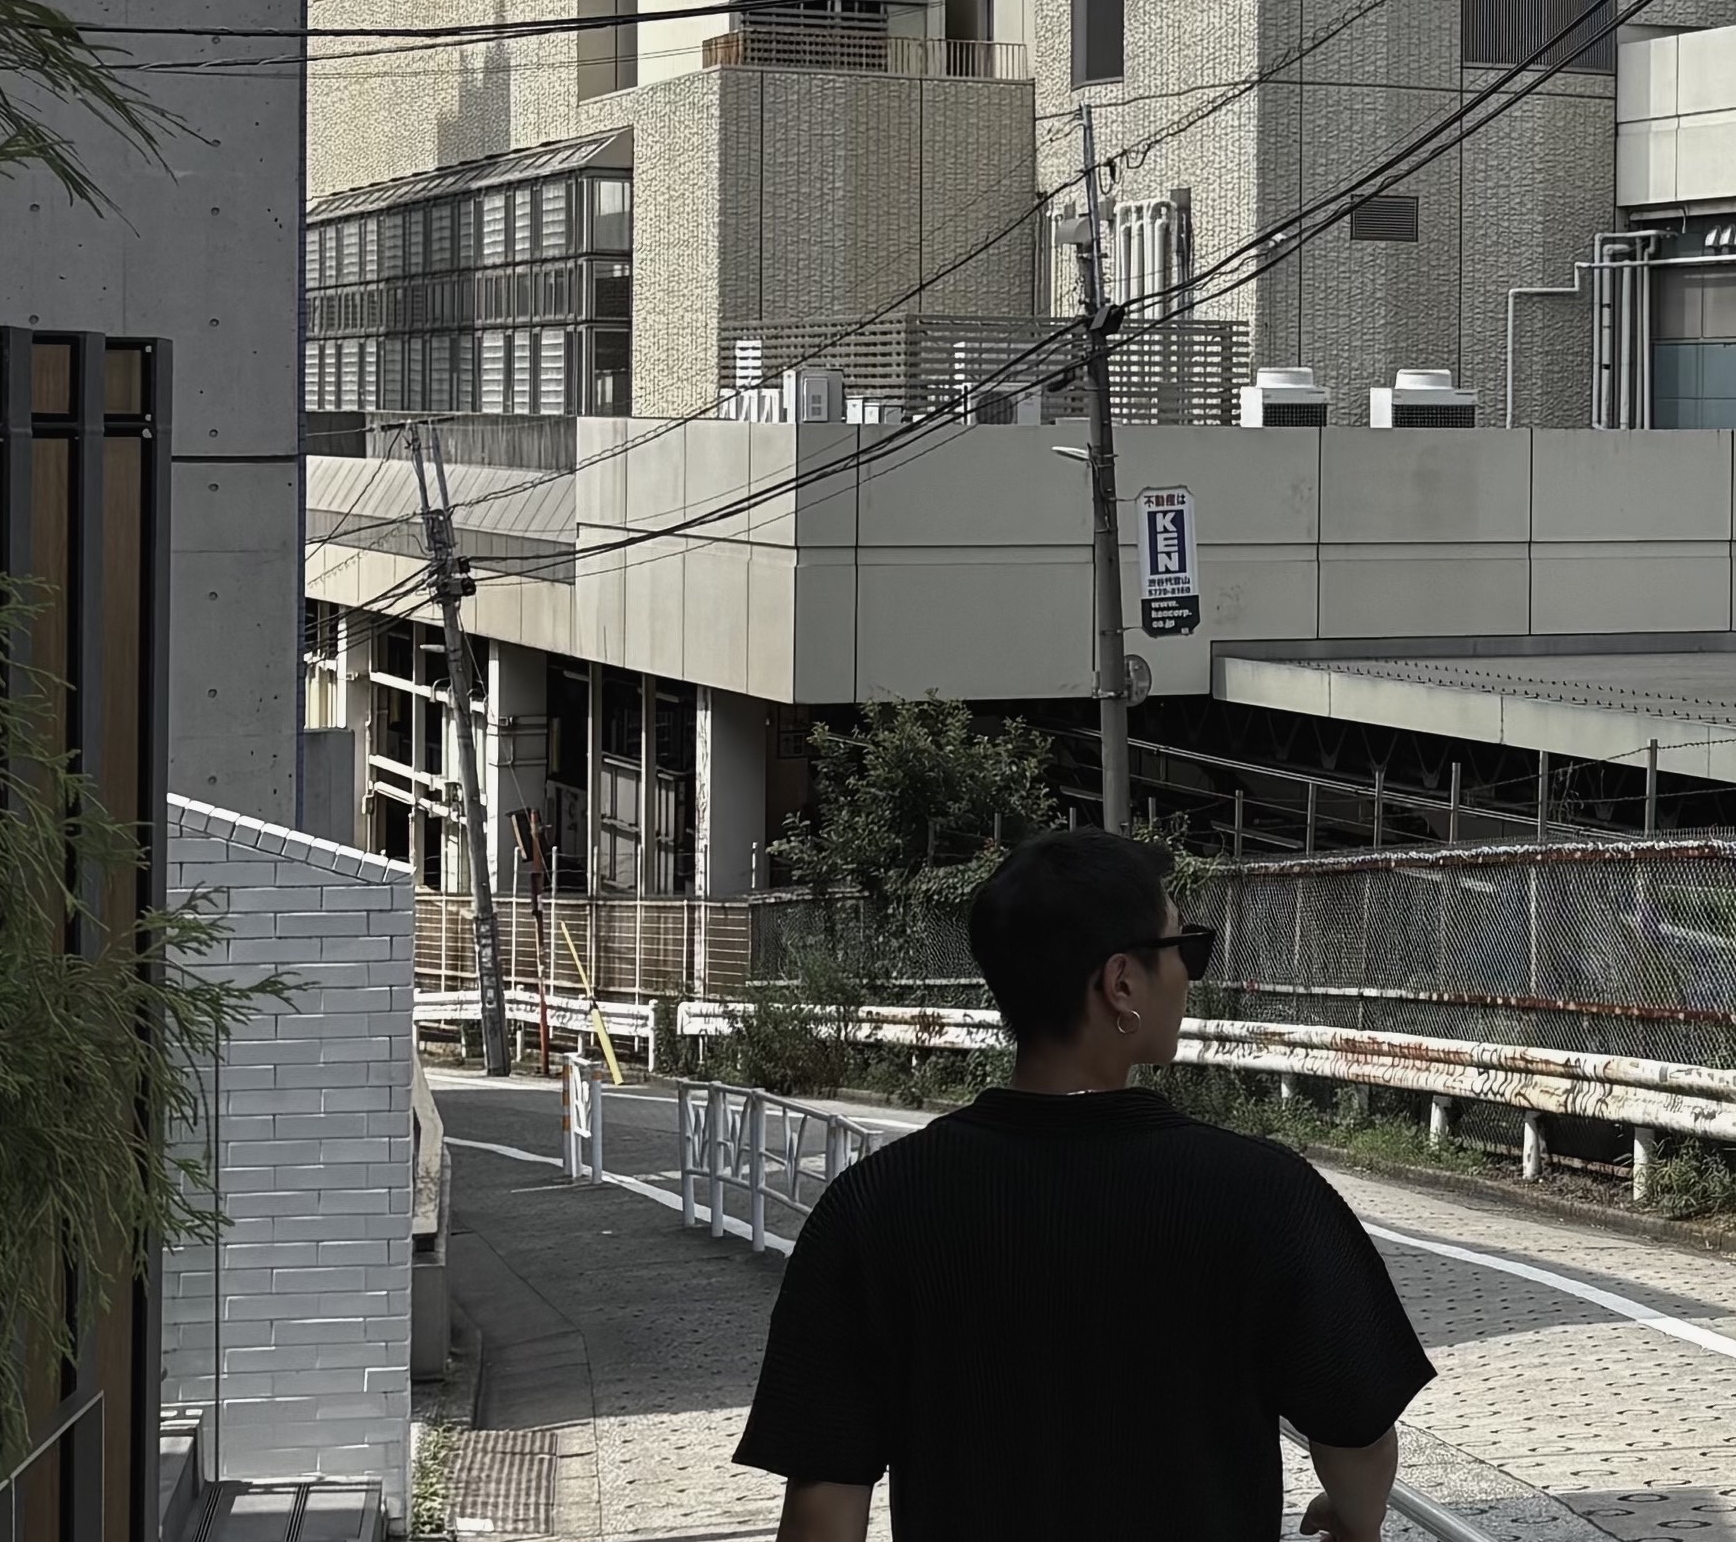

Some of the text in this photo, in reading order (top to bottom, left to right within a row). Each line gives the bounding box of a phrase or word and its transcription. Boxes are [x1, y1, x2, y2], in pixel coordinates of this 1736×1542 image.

[1143, 493, 1186, 508] 不動産は
[1156, 511, 1179, 572] KEN
